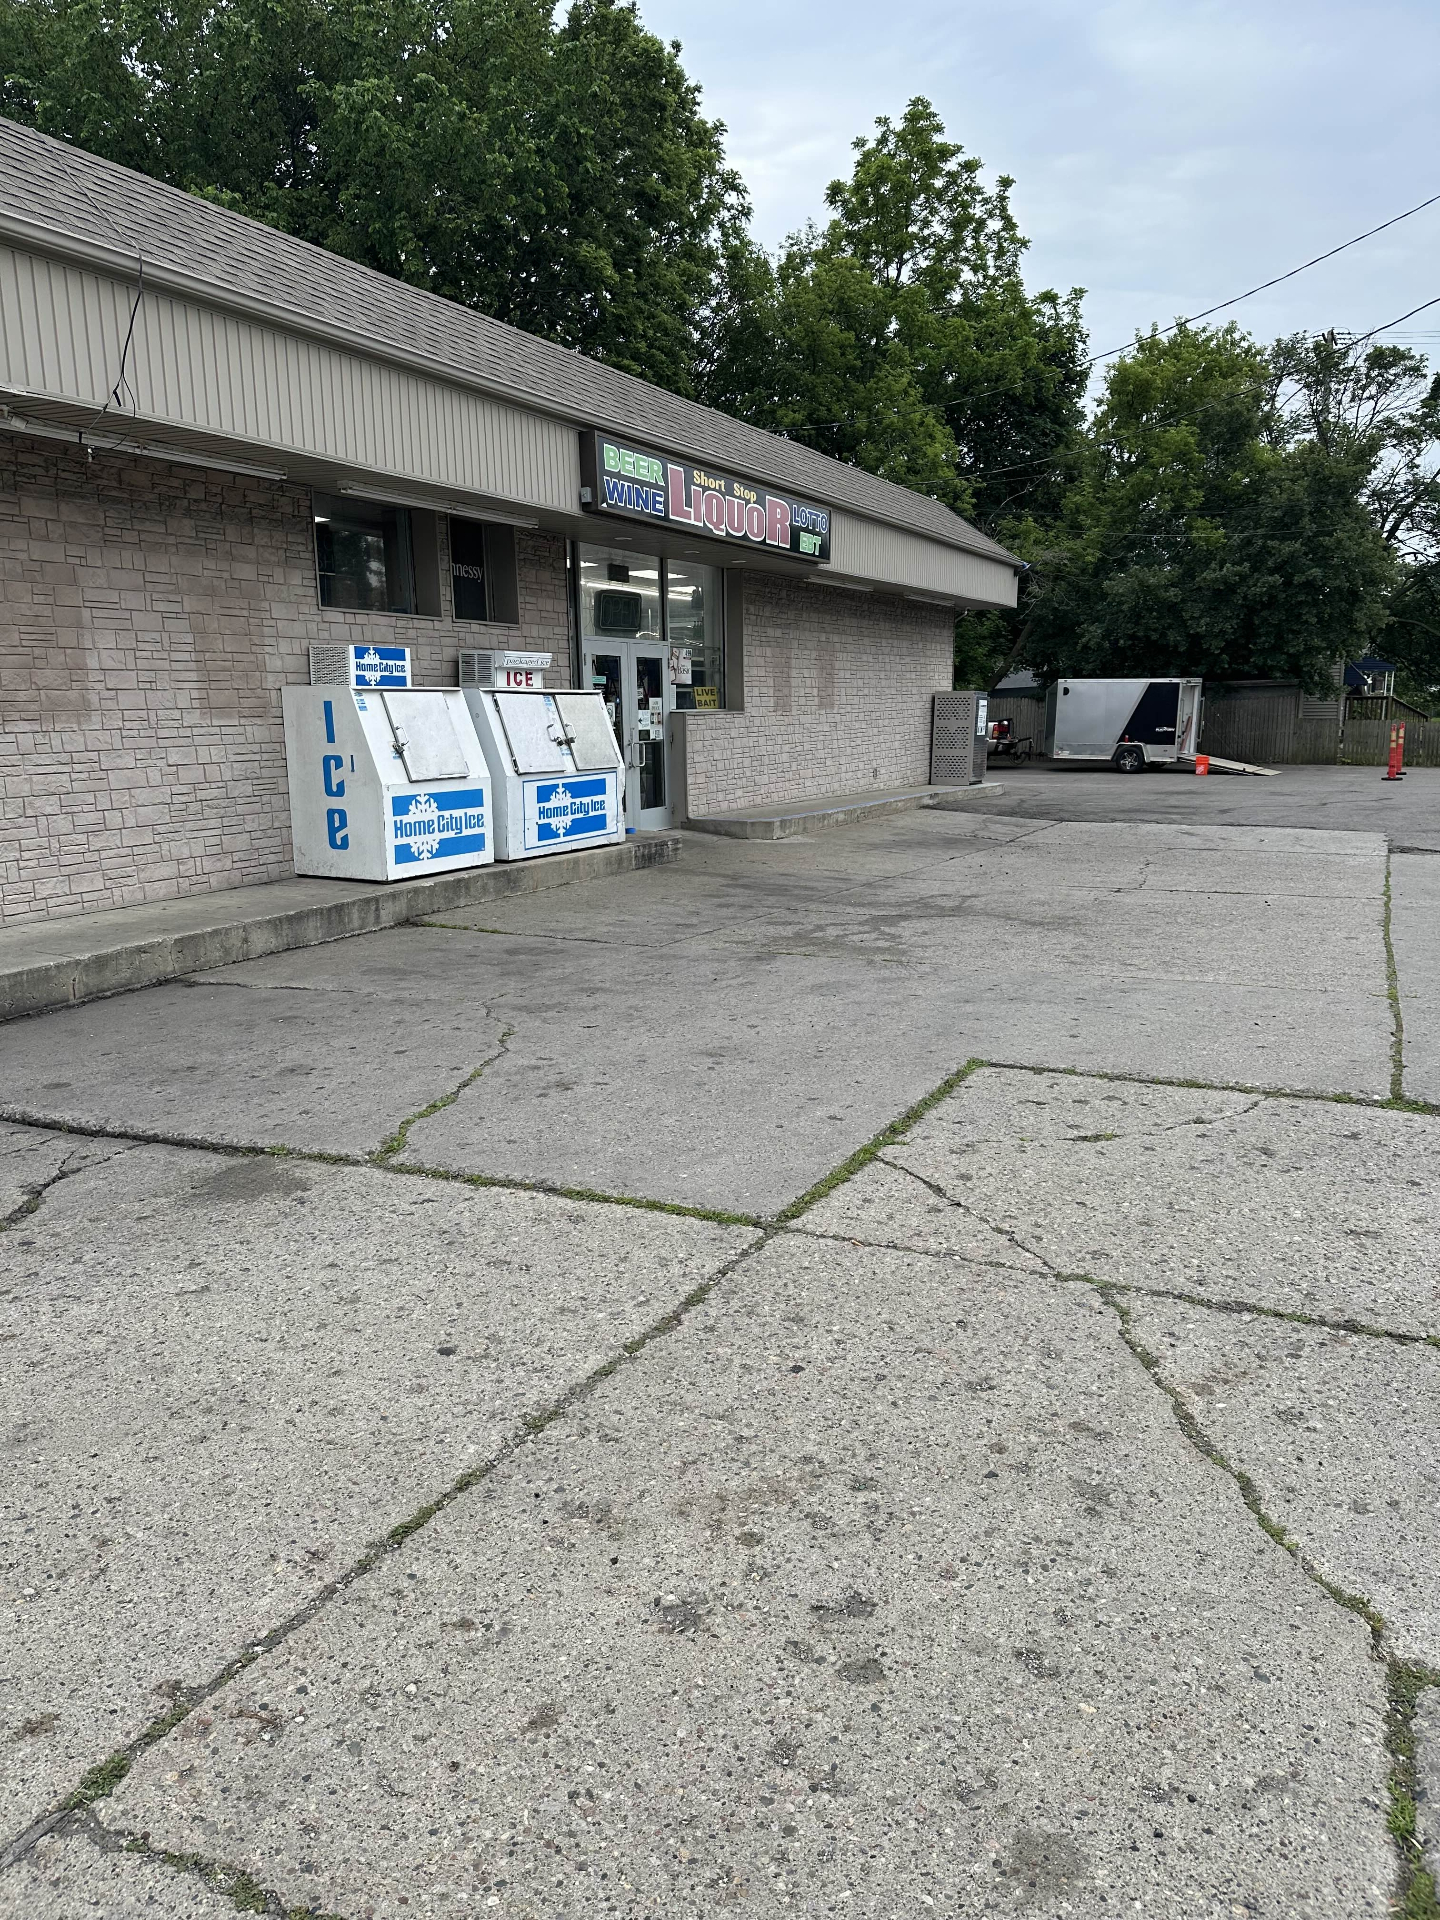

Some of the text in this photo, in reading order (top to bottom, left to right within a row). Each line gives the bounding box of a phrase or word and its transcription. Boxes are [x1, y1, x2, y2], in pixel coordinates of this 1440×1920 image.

[603, 443, 665, 487] BEER
[603, 476, 665, 517] WINE
[693, 470, 757, 503] Short Stop
[667, 463, 791, 548] LIQUOR
[792, 504, 828, 533] LOTTO
[799, 531, 822, 556] EBT
[602, 597, 639, 626] OPEN
[355, 660, 406, 675] Home City Ice
[506, 670, 534, 687] ICE
[696, 688, 716, 696] LIVE
[696, 699, 717, 707] BAIT
[323, 700, 350, 850] Ice
[538, 799, 606, 820] Home City Ice
[394, 812, 485, 839] Home City Ice
